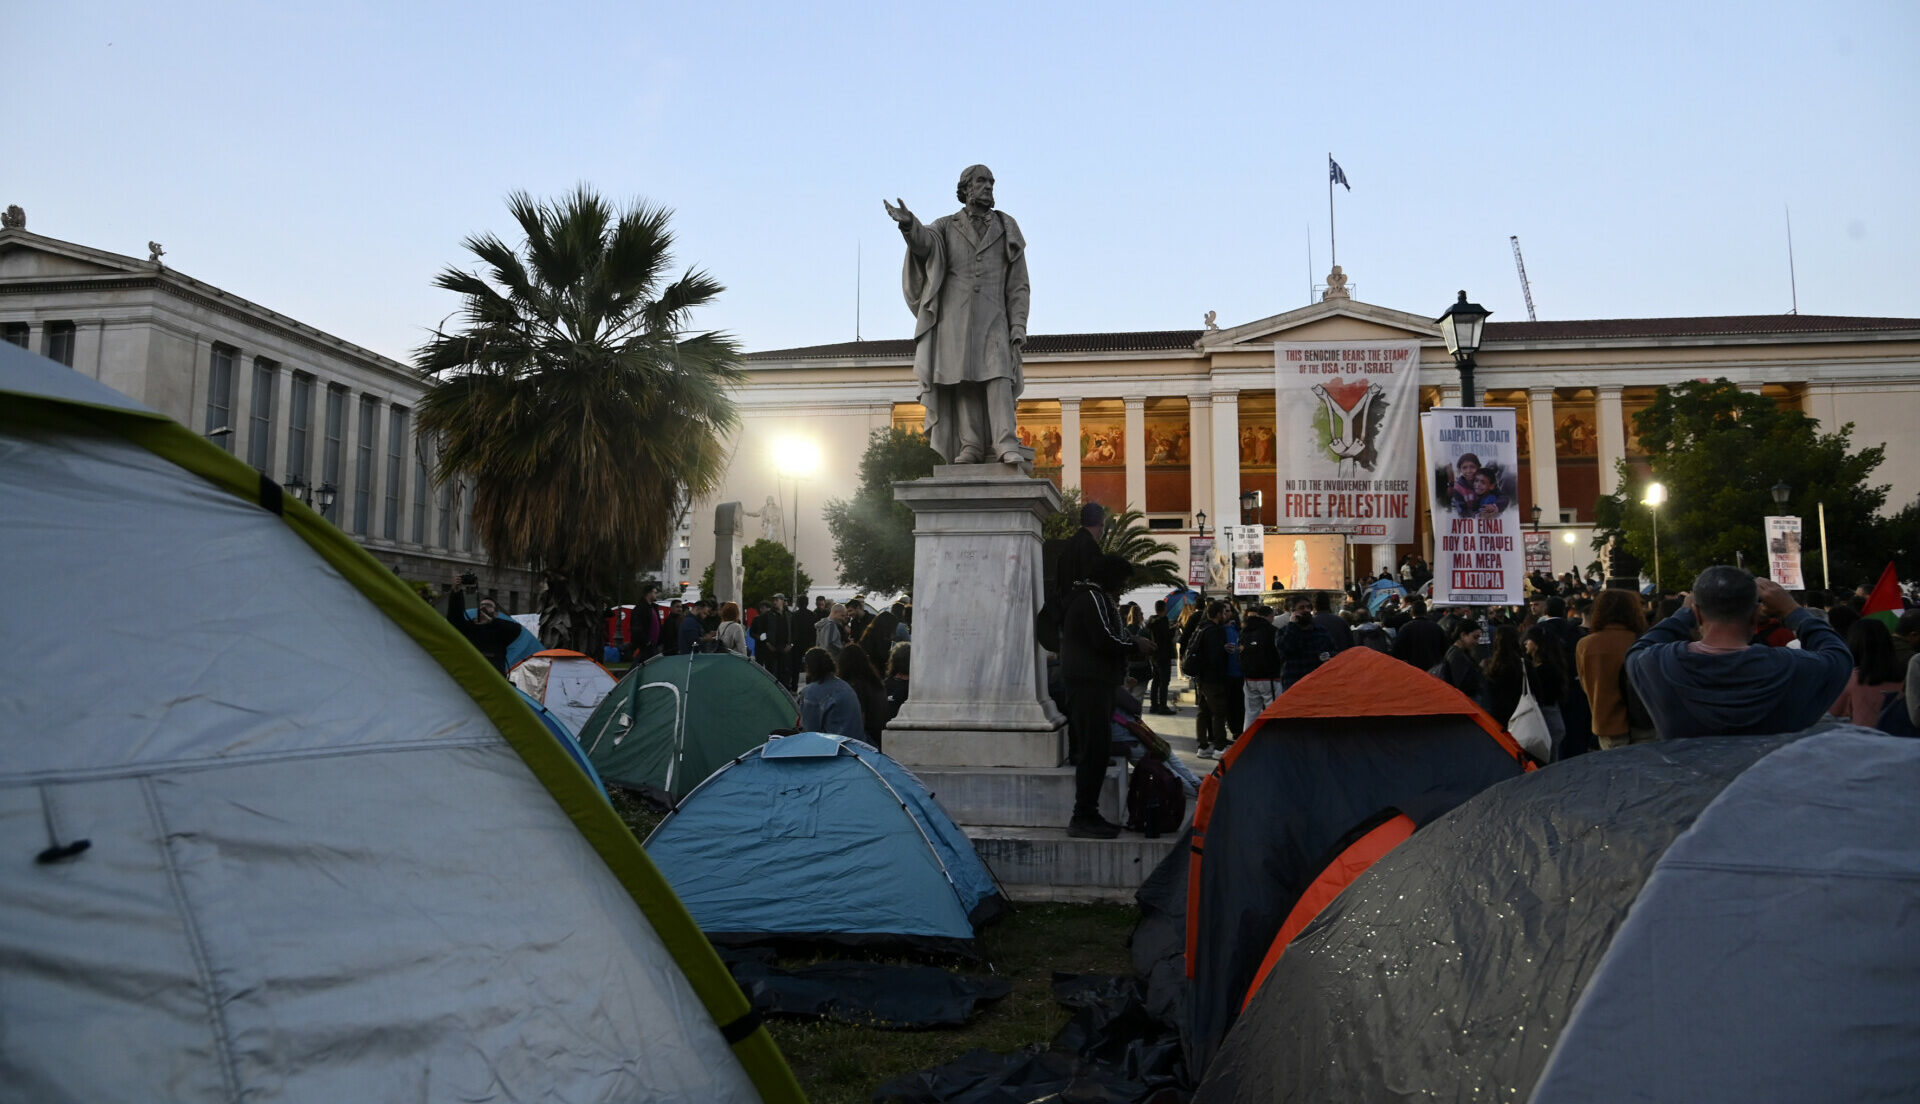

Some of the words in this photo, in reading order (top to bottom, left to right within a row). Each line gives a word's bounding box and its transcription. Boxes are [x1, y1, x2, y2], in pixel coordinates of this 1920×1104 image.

[1285, 349, 1302, 361] THIS
[1304, 349, 1340, 361] GENOCIDE
[1342, 349, 1366, 361] BEARS
[1367, 349, 1381, 361] THE
[1383, 349, 1409, 361] STAMP
[1299, 364, 1307, 374] OF
[1308, 364, 1319, 374] THE
[1321, 362, 1339, 374] USA
[1346, 362, 1357, 374] EU
[1364, 362, 1394, 374] ISRAEL
[1454, 415, 1463, 428] ΤΟ
[1466, 415, 1493, 428] ΙΣΡΑΗΛ
[1439, 429, 1482, 442] ΔΙΑΠΡΑΤΤΕΙ
[1484, 430, 1510, 443] ΣΦΑΓΗ
[1286, 480, 1296, 491] NO
[1298, 480, 1307, 491] TO
[1309, 480, 1321, 491] THE
[1323, 480, 1372, 491] INVOLVEMENT
[1374, 480, 1383, 491] OF
[1384, 480, 1409, 491] GREECE
[1285, 494, 1322, 518] FREE
[1327, 494, 1409, 518] PALESTINE
[1452, 519, 1473, 534] ΑΥΤΟ
[1478, 519, 1503, 534] ΕΙΝΑΙ
[1443, 536, 1459, 551] ΠΟΥ
[1463, 536, 1476, 551] ΘΑ
[1479, 536, 1513, 551] ΓΡΑΨΕΙ
[1454, 553, 1472, 568] ΜΙΑ
[1476, 553, 1502, 568] ΜΕΡΑ
[1454, 572, 1461, 588] Η
[1465, 572, 1501, 588] ΙΣΤΟΡΙΑ
